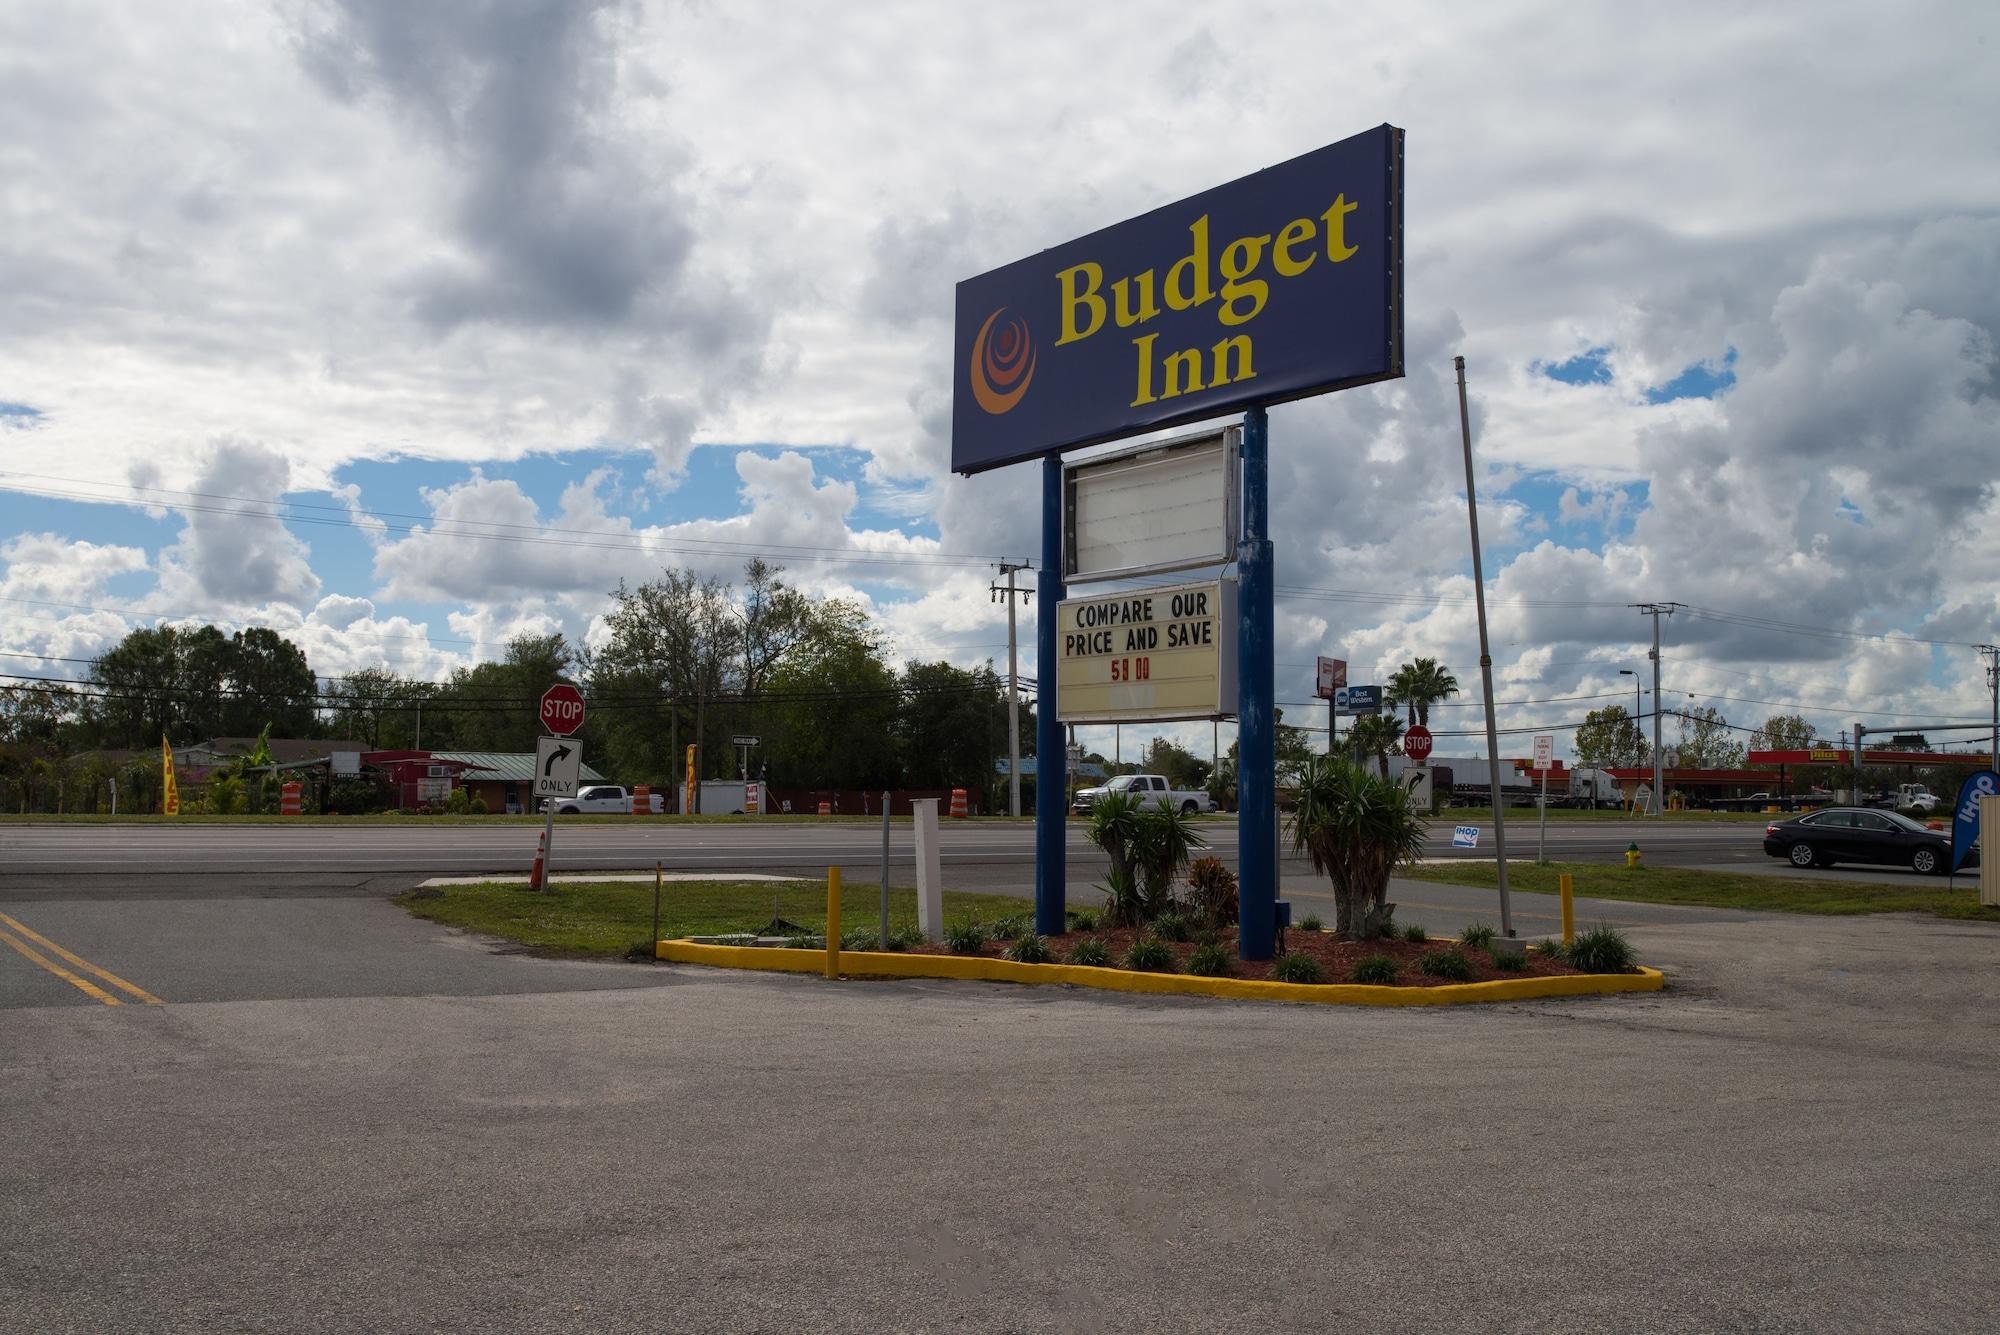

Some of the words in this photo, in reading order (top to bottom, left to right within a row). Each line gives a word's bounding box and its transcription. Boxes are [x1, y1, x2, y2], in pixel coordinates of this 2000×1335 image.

[1054, 192, 1360, 347] Budget
[1130, 332, 1258, 408] Inn
[1076, 598, 1153, 628] COMPARE
[1171, 592, 1207, 618] OUR
[1066, 631, 1113, 656] PRICE
[1126, 627, 1158, 651] AND
[1167, 621, 1212, 648] SAVE
[543, 699, 583, 720] STOP
[1405, 736, 1431, 750] STOP
[541, 780, 572, 793] ONLY
